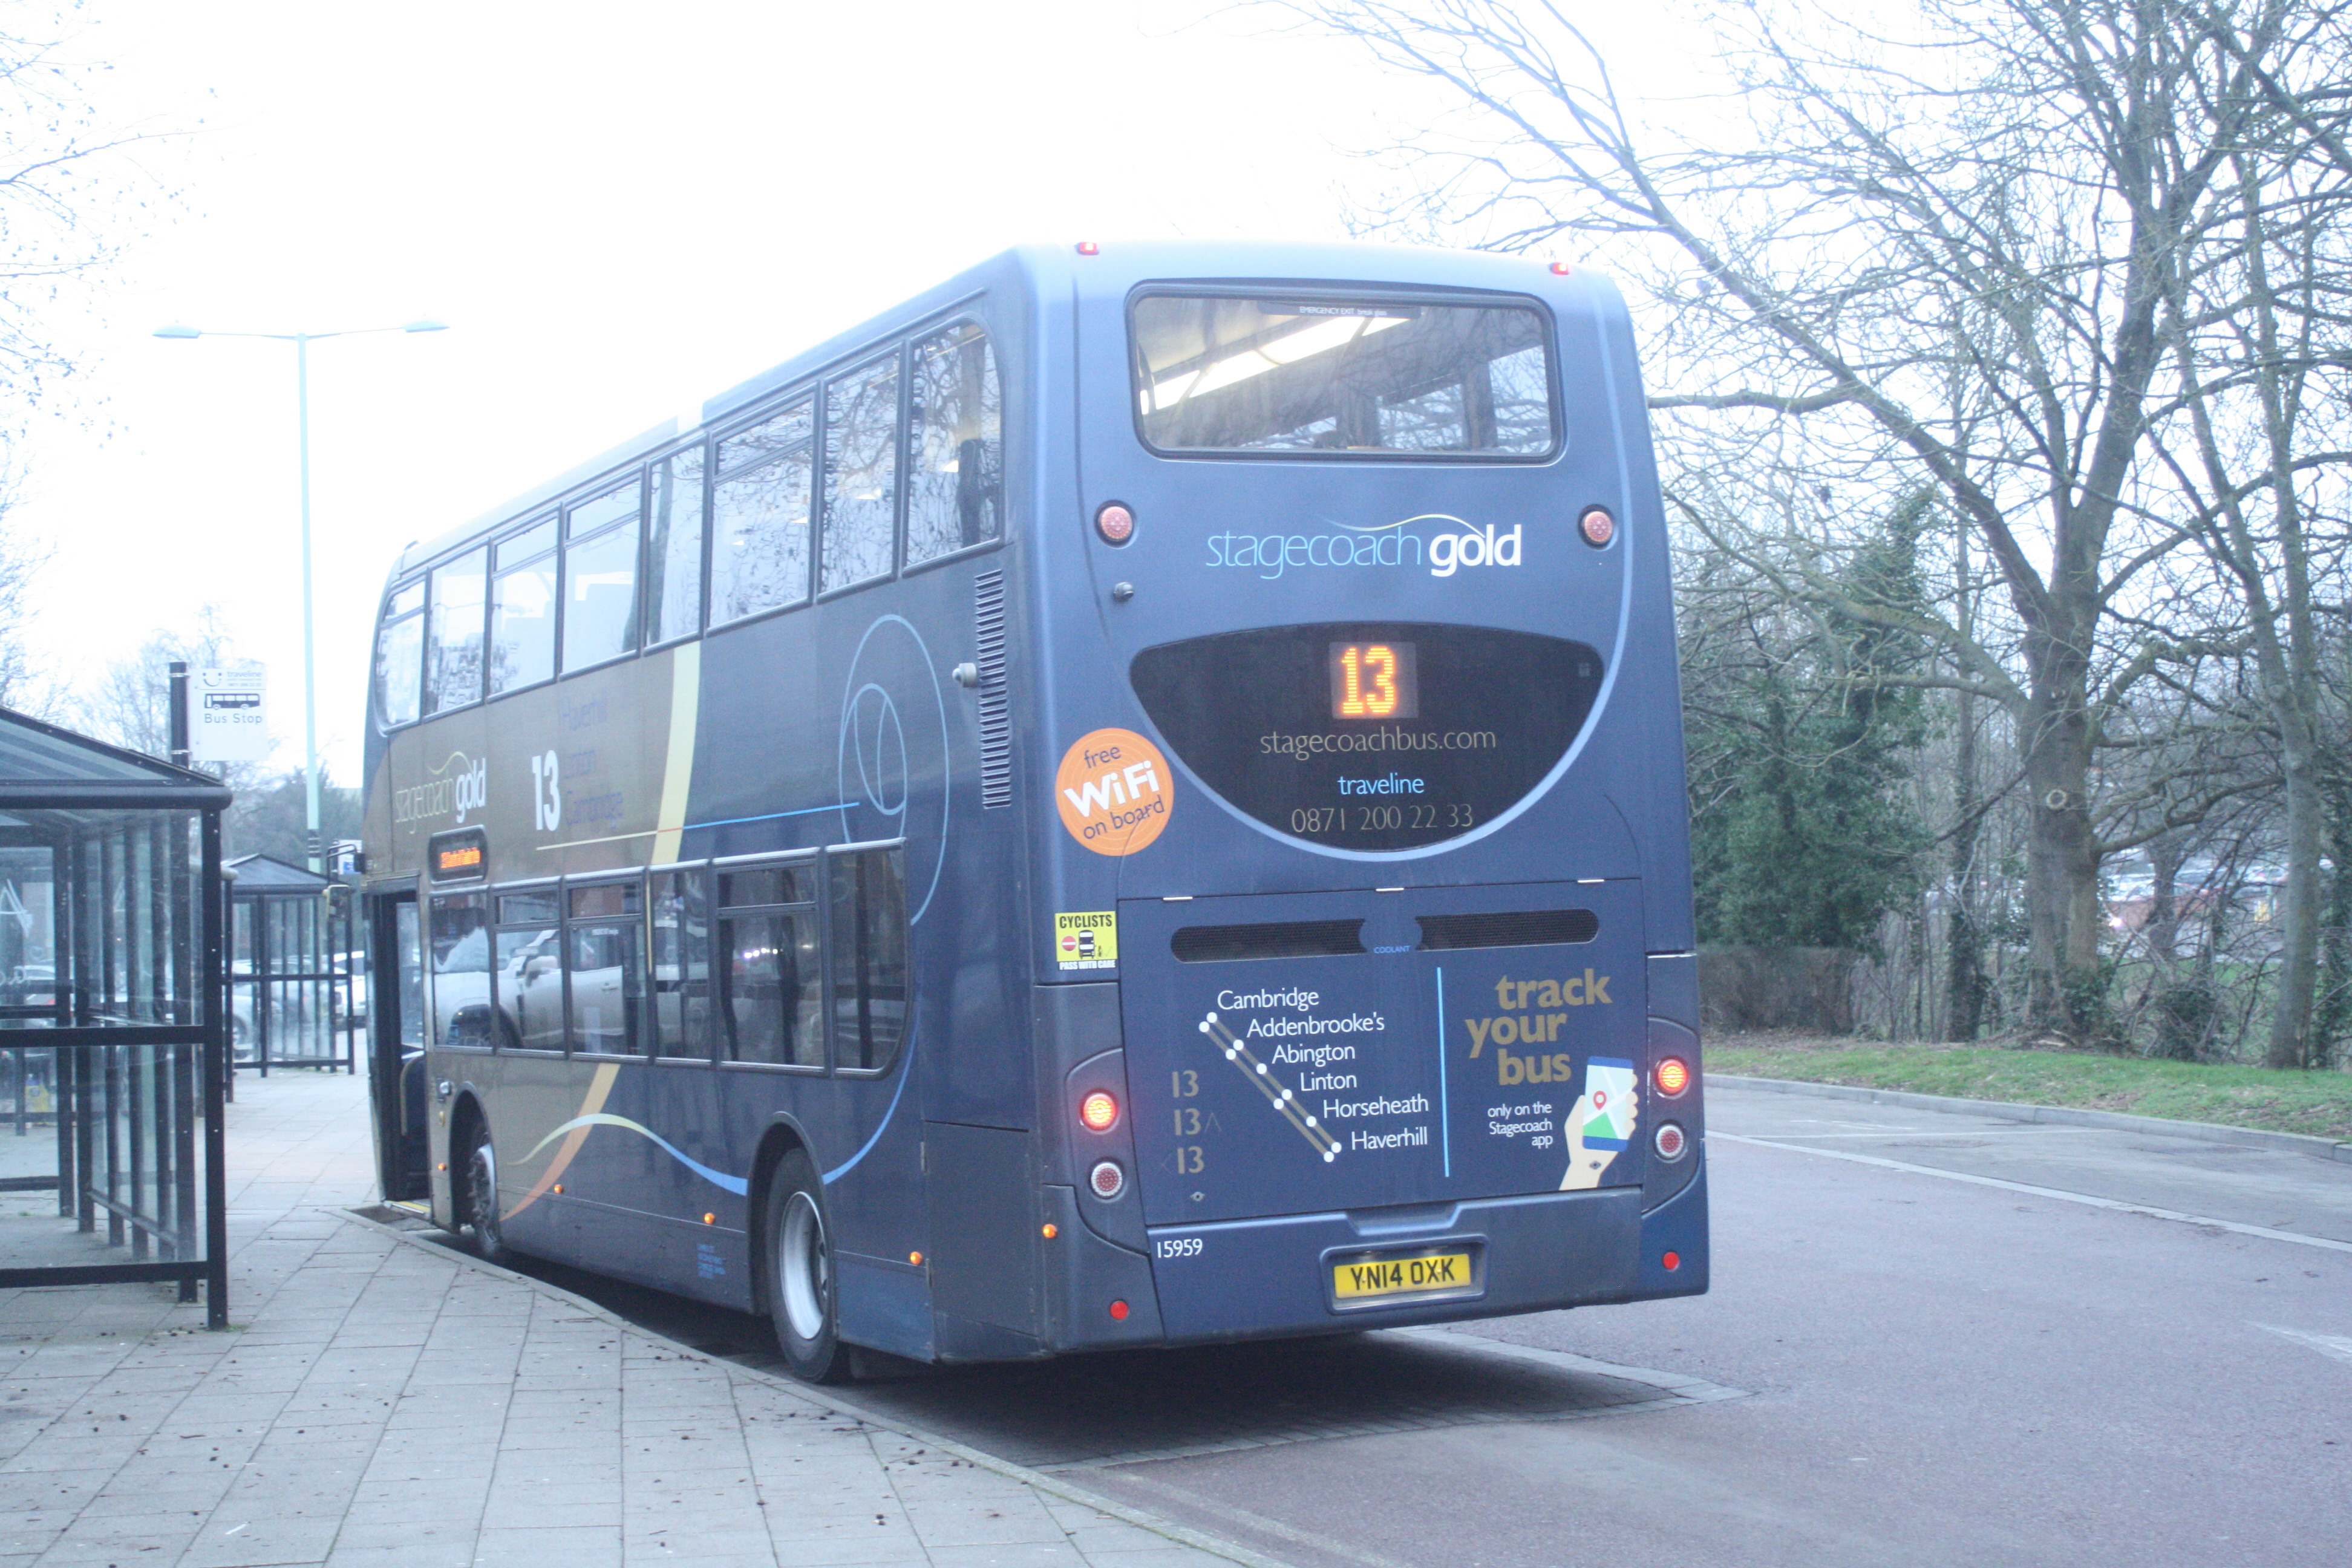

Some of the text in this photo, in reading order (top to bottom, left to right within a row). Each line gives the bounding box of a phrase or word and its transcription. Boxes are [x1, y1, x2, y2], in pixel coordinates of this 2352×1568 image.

[1299, 306, 1340, 315] EMERGENCY
[1206, 524, 1521, 579] stagecoach gold
[1341, 646, 1394, 714] 13
[204, 713, 263, 725] Bus Stop
[1260, 727, 1496, 760] stagecoachbus.com
[1084, 746, 1121, 769] free
[456, 757, 486, 824] gold
[532, 750, 561, 831] 13
[1063, 760, 1160, 817] WiFi
[1338, 773, 1425, 795] traveline
[1083, 794, 1165, 839] on board
[1292, 803, 1473, 833] 0871 200 22 33
[1059, 914, 1112, 929] CYCLISTS
[1373, 946, 1411, 954] COOLANT
[1059, 959, 1116, 970] PASS WITH CARE
[1217, 988, 1319, 1011] Cambridge
[1495, 968, 1612, 1010] track
[1247, 1011, 1385, 1039] Addenbrooke's
[1465, 1013, 1567, 1059] your
[1272, 1044, 1355, 1067] Abington
[1498, 1049, 1571, 1085] bus
[1172, 1070, 1199, 1098] 13
[1300, 1073, 1357, 1091] Linton
[1324, 1094, 1428, 1119] Horseheath
[1488, 1102, 1552, 1120] only on the
[1351, 1126, 1428, 1150] Haverhill
[1489, 1119, 1552, 1137] Stagecoach
[1532, 1135, 1553, 1149] app
[1157, 1238, 1203, 1258] 15959
[1350, 1259, 1454, 1290] YN14 OXK
